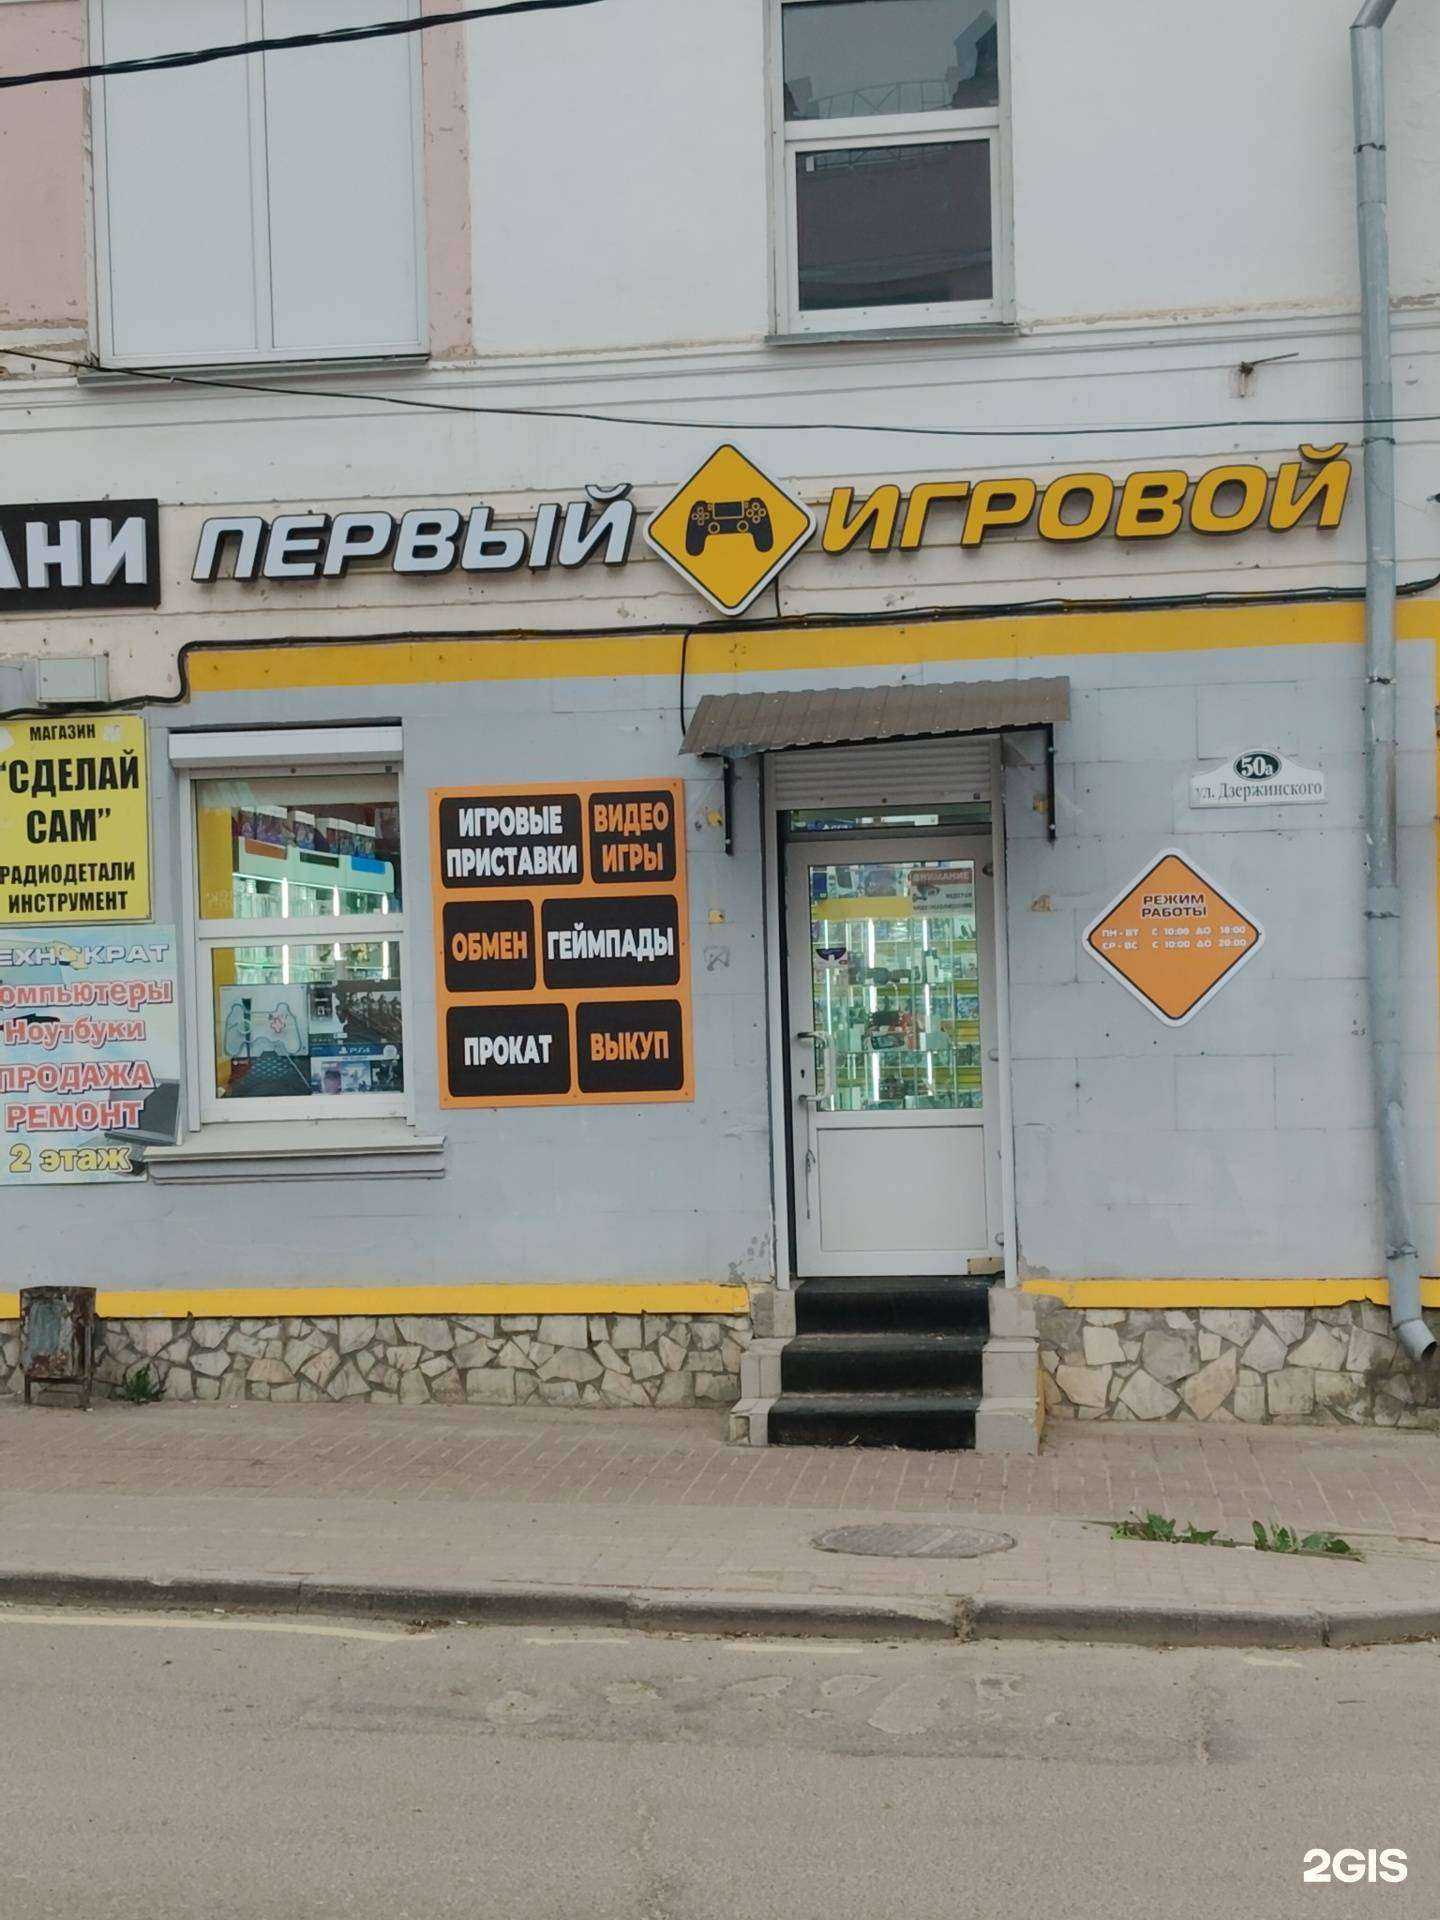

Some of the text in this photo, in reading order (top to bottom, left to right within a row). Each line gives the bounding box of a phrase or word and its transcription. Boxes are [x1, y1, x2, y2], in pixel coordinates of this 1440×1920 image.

[191, 443, 1351, 582] ПЕРВЫЙ ИГРОВОЙ
[29, 724, 96, 741] МАГАЗИН
[1218, 782, 1323, 802] Дзержинского
[458, 805, 563, 837] ИГРОВЫЕ
[593, 802, 669, 837] ВИДЕО
[446, 845, 578, 878] ПРИСТАВКИ
[602, 843, 664, 873] ИГРЫ
[0, 862, 135, 887] РАДИОДЕТАЛИ
[8, 891, 128, 914] ИНСТРУМЕНТ
[1141, 907, 1207, 918] РАБОТЫ
[1143, 895, 1204, 906] РЕЖИМ
[452, 931, 527, 961] ОБМЕН
[547, 922, 674, 962] ГЕЙМПАДЫ
[4, 1016, 146, 1050] Ноутбуки
[590, 1031, 669, 1061] ВЫКУП
[464, 1035, 552, 1066] ПРОКАТ
[0, 1061, 156, 1094] ПРОДАЖА
[6, 1102, 142, 1131] РЕМОНТ
[10, 1144, 132, 1173] 2 этаж
